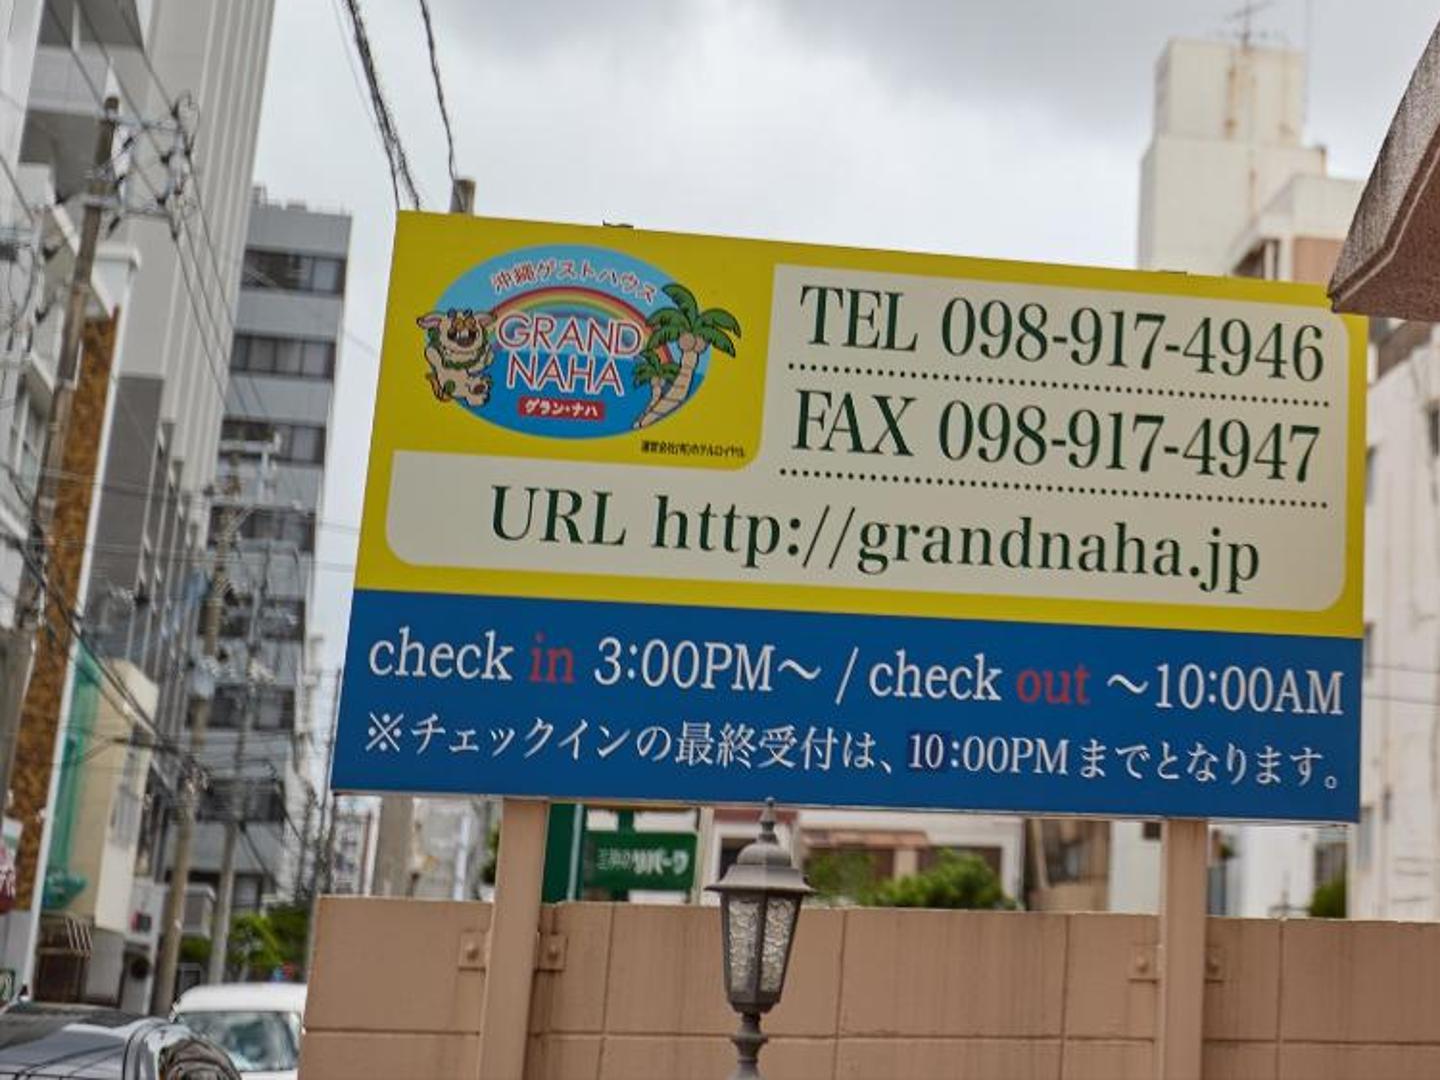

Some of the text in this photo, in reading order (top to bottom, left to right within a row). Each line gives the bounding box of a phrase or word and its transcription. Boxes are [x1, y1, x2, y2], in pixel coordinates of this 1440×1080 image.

[490, 256, 659, 306] 沖縄ゲストハウス
[496, 311, 643, 358] GRAND
[800, 284, 1325, 383] TEL 098-917-4946
[505, 352, 625, 397] NAHA
[525, 397, 599, 418] グラン・ナハ
[791, 389, 1321, 484] FAX 098-917-4947
[490, 483, 1261, 595] URL http://grandnaha.jp
[368, 625, 514, 681] check
[528, 632, 577, 684] in
[869, 648, 1003, 702] check
[1015, 664, 1092, 705] out
